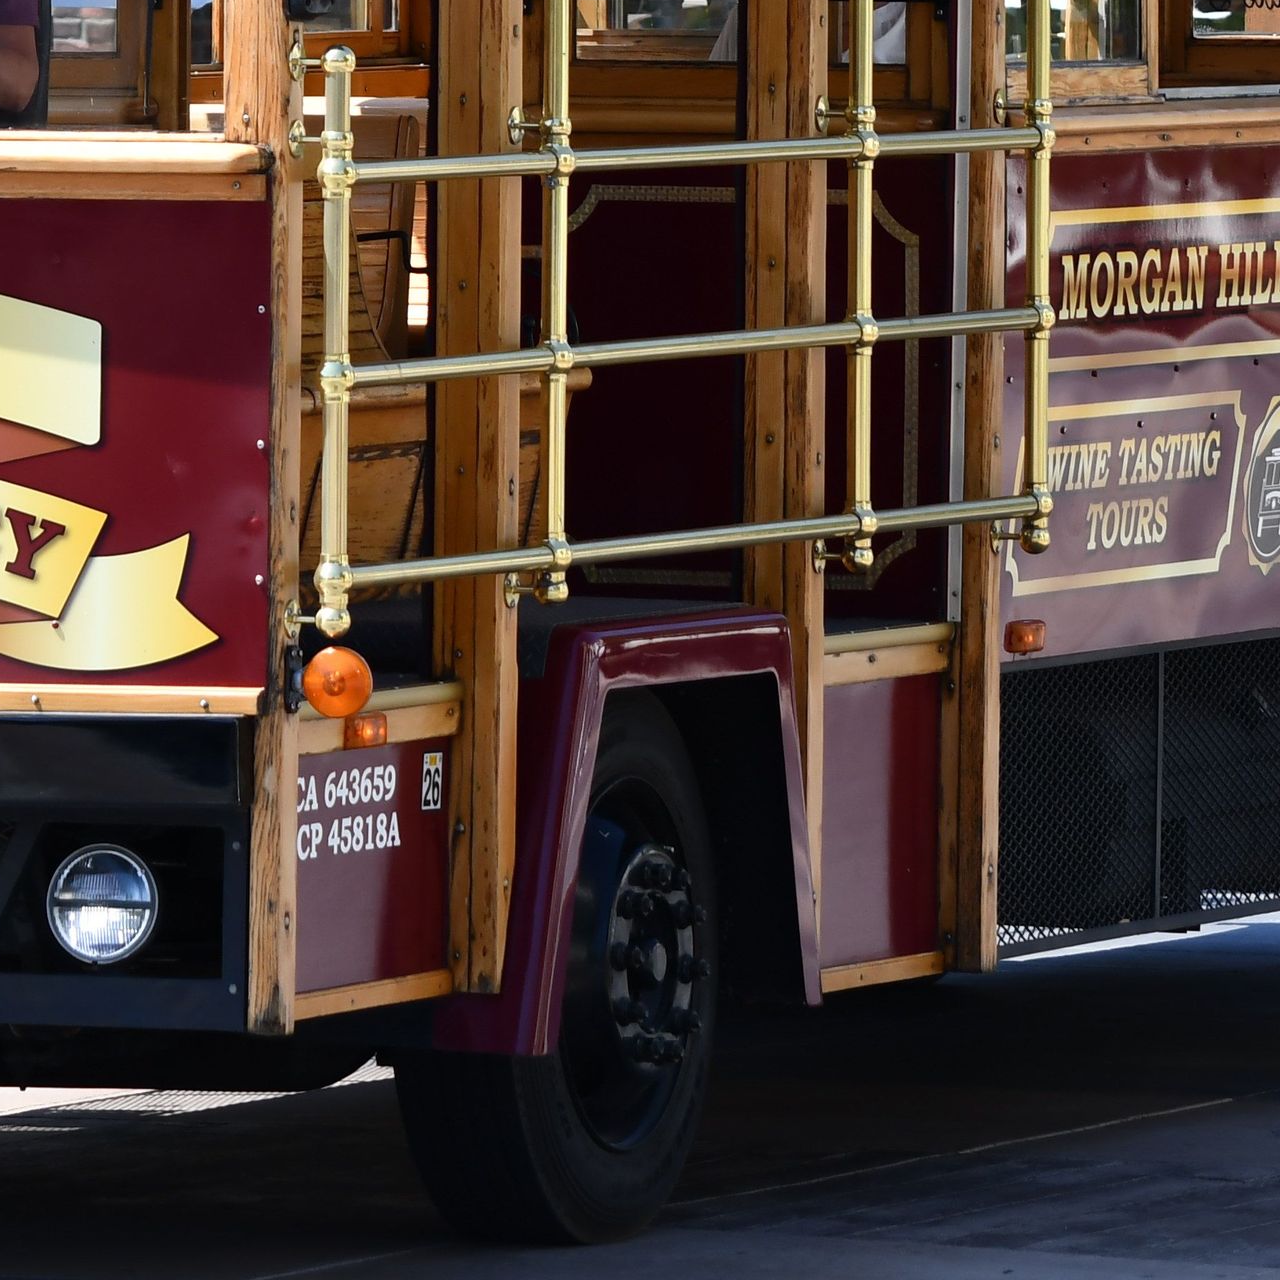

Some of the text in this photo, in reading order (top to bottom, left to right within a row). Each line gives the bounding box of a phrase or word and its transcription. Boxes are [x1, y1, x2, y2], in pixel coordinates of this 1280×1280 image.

[1058, 245, 1209, 320] MORGAN
[1047, 430, 1222, 492] WINE TASTING
[1085, 496, 1169, 551] TOURS
[296, 764, 396, 814] CA 643659
[423, 767, 441, 807] 26
[296, 811, 401, 861] CP 45818A
